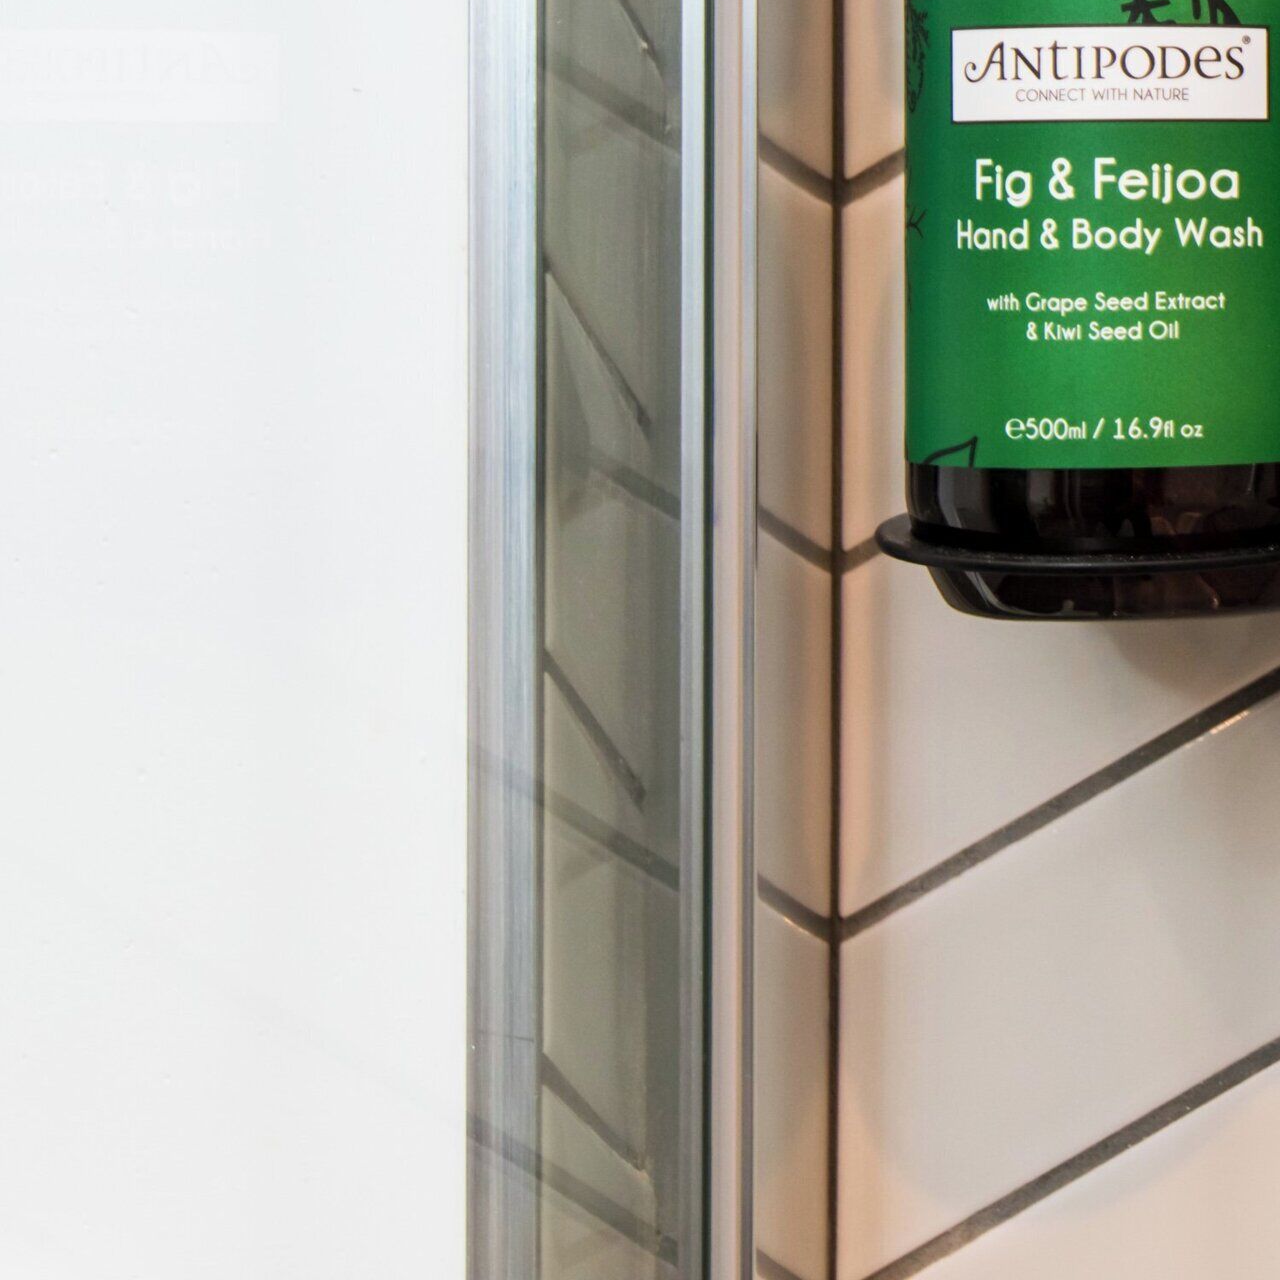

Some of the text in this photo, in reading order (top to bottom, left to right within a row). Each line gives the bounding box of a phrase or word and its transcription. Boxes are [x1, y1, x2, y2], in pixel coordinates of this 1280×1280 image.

[1016, 87, 1190, 102] CONNECT WITH NATURE
[975, 157, 1240, 208] Fig & Feijoa
[957, 216, 1264, 255] Hand & Body Wash
[986, 290, 1226, 317] with Grape Seed Extract
[1026, 320, 1179, 341] & Kiwi Seed Oil
[1092, 417, 1105, 441] /
[1113, 416, 1174, 440] 16.9fl
[1180, 423, 1204, 438] oz
